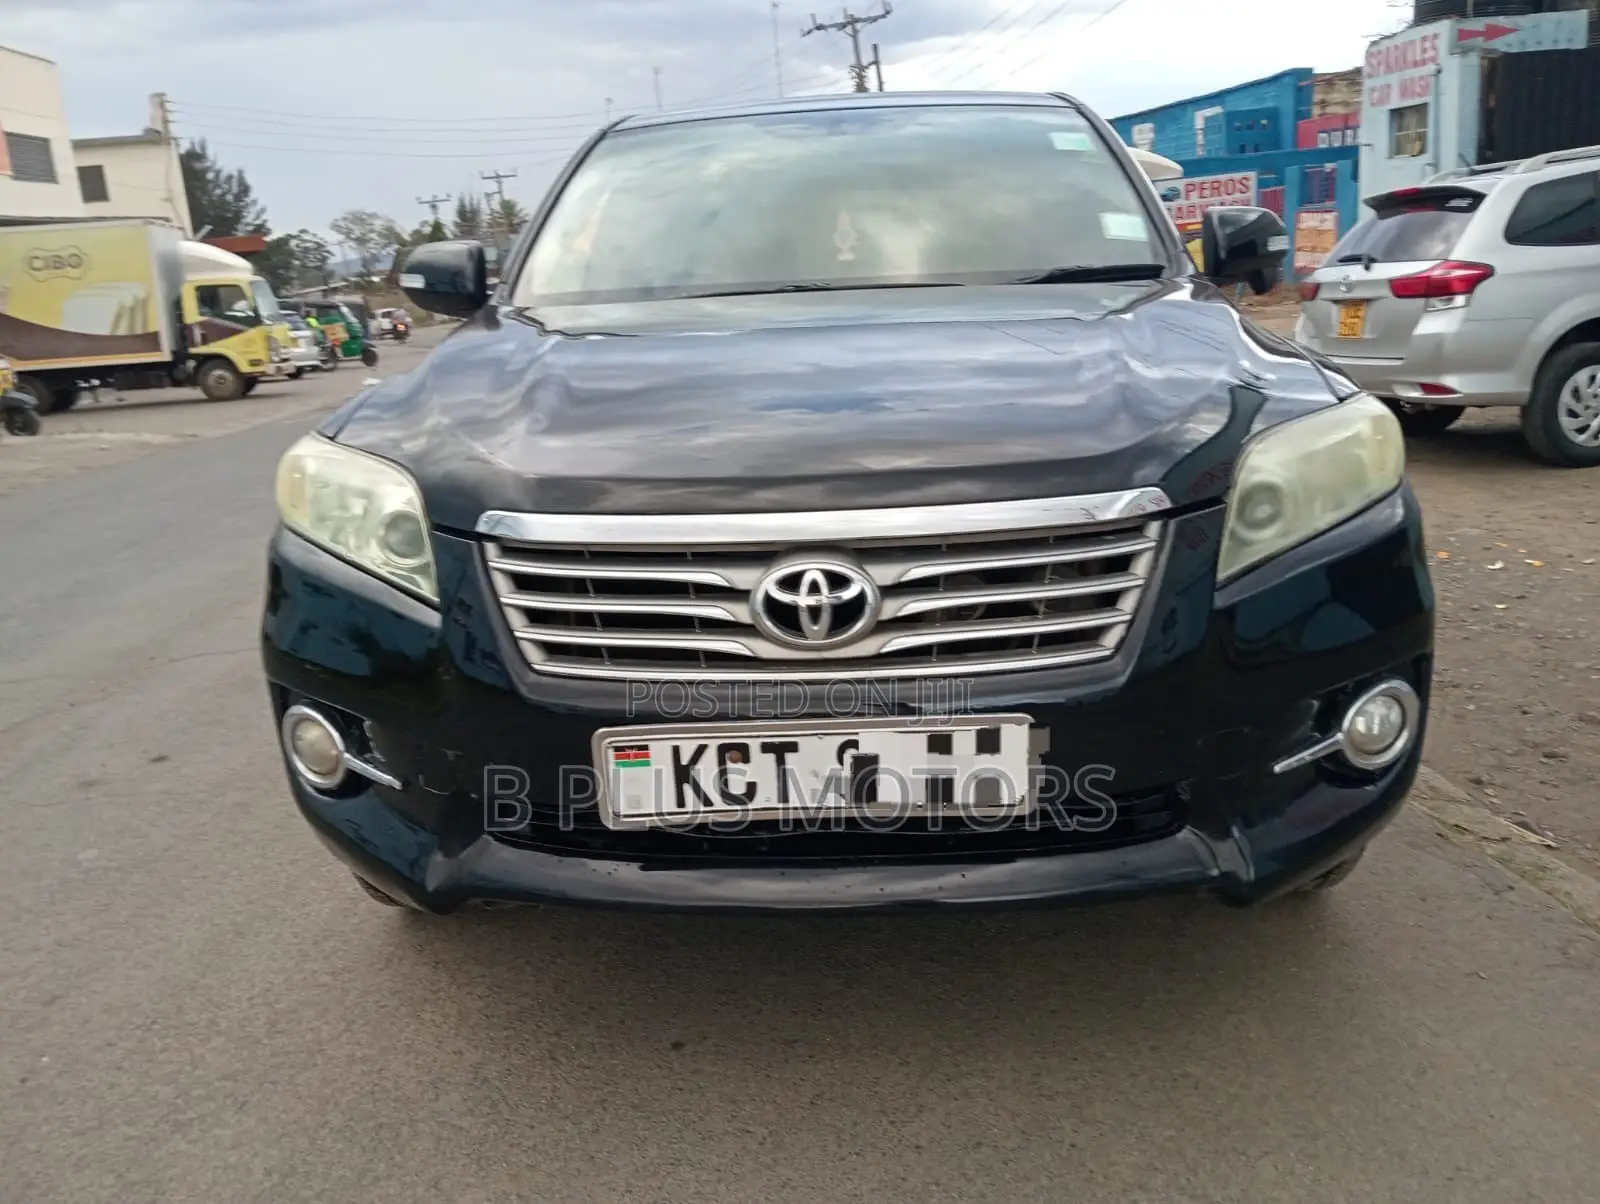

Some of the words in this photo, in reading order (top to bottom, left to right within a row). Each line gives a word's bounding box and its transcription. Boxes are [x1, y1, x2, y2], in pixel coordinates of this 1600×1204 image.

[1184, 176, 1250, 200] PEROS
[29, 253, 83, 272] CIBO
[671, 741, 799, 809] KCT
